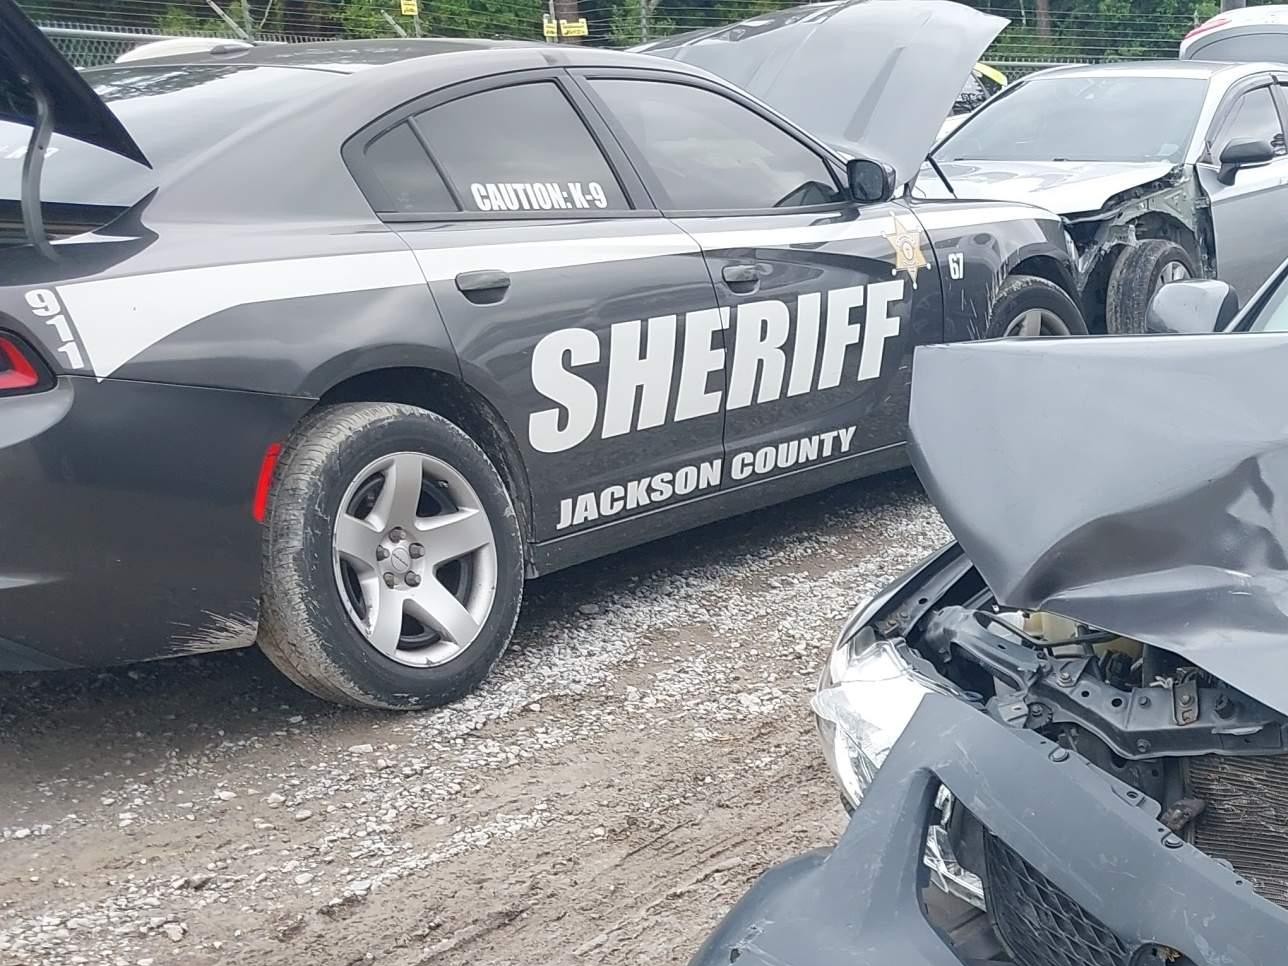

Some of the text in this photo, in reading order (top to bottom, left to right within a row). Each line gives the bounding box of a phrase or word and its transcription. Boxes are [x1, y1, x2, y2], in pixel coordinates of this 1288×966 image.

[470, 181, 608, 211] CAUTION: K-9
[948, 252, 964, 280] 67
[24, 288, 85, 370] 911
[528, 279, 905, 453] SHERIFF
[556, 426, 857, 531] JACKSON COUNTY
